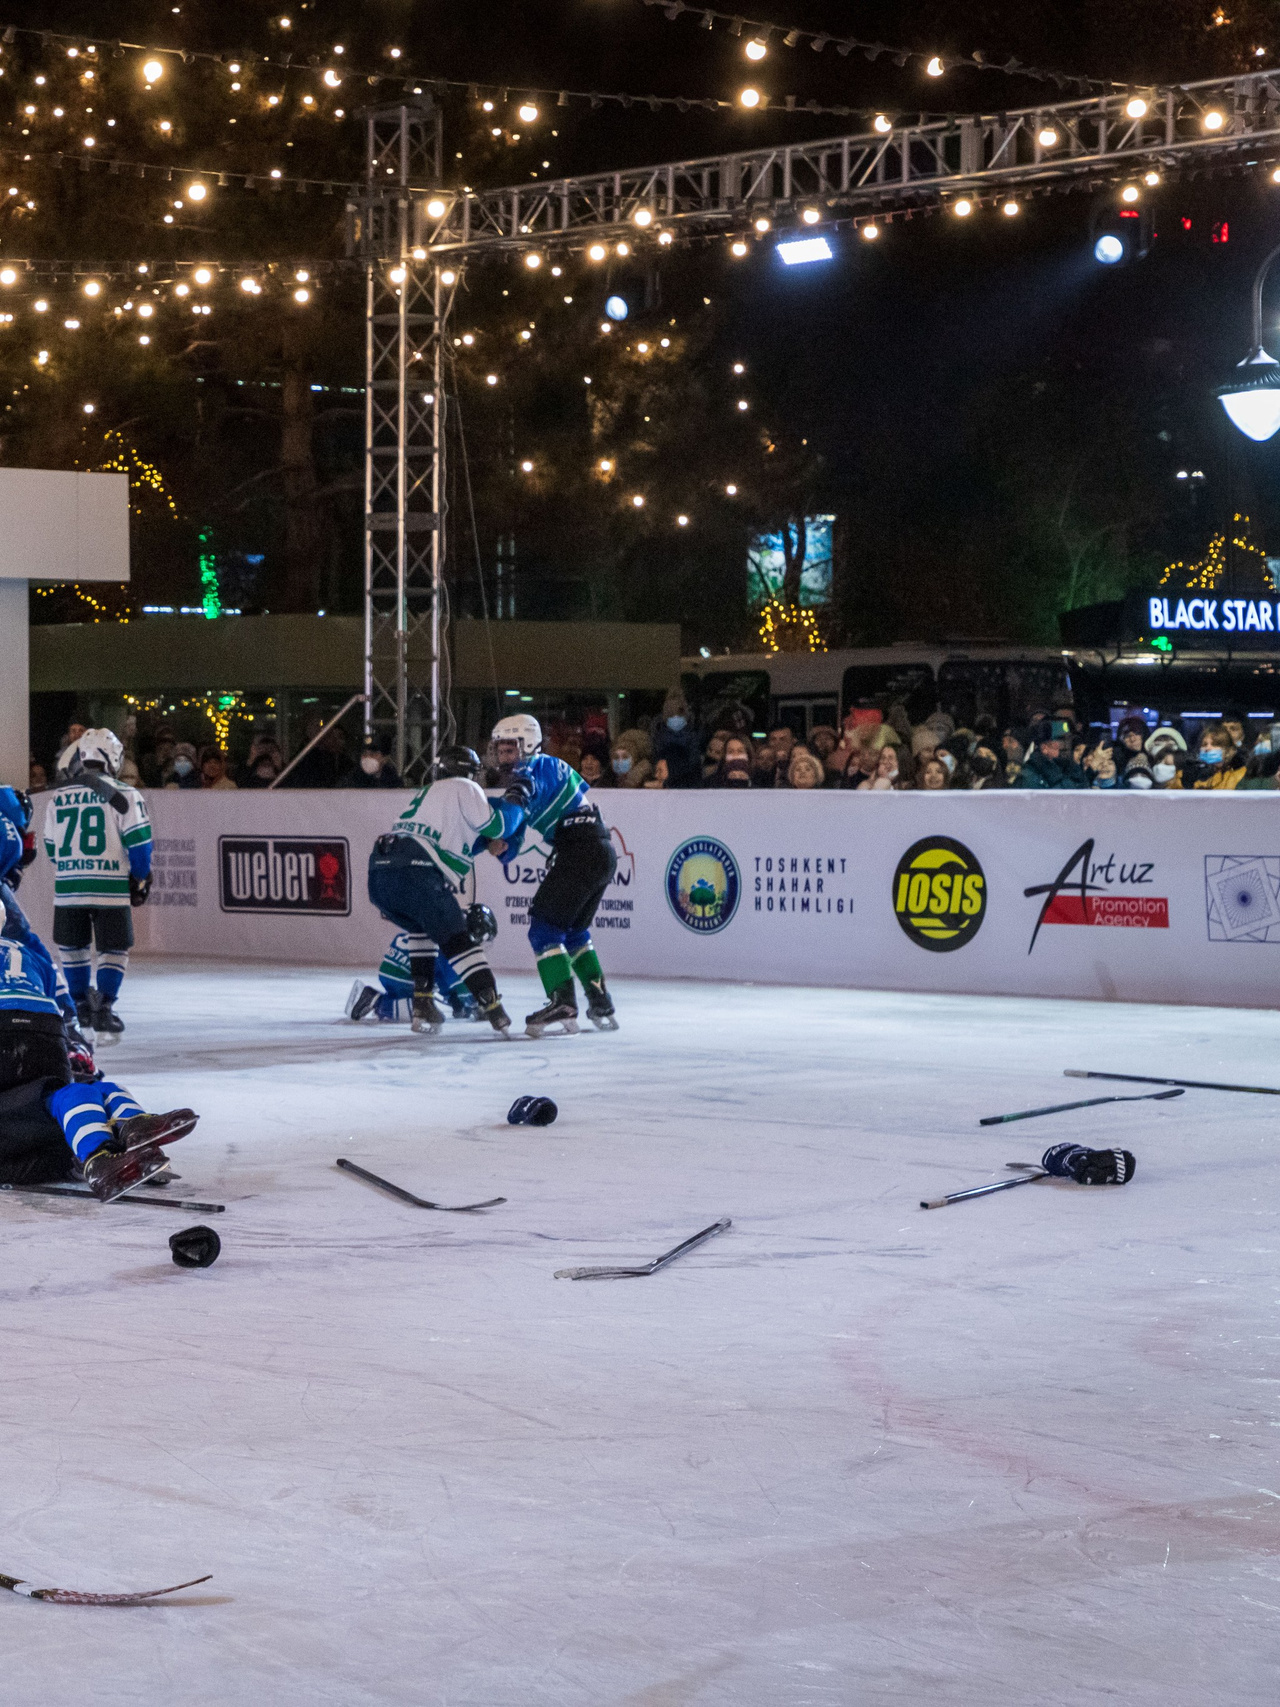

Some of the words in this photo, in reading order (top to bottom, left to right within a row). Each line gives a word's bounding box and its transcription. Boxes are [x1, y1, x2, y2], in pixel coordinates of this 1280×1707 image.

[1149, 597, 1219, 629] BLACK
[1222, 599, 1275, 631] STAR
[563, 815, 597, 827] CCM
[56, 806, 106, 857] 78
[228, 838, 316, 901] weber
[755, 857, 847, 874] TOSHKENT
[755, 877, 825, 894] SHAHAR
[896, 872, 984, 916] IOSIS
[755, 897, 855, 914] HOKIMLIGI
[1091, 897, 1166, 914] Promotion
[1093, 913, 1151, 927] Agency
